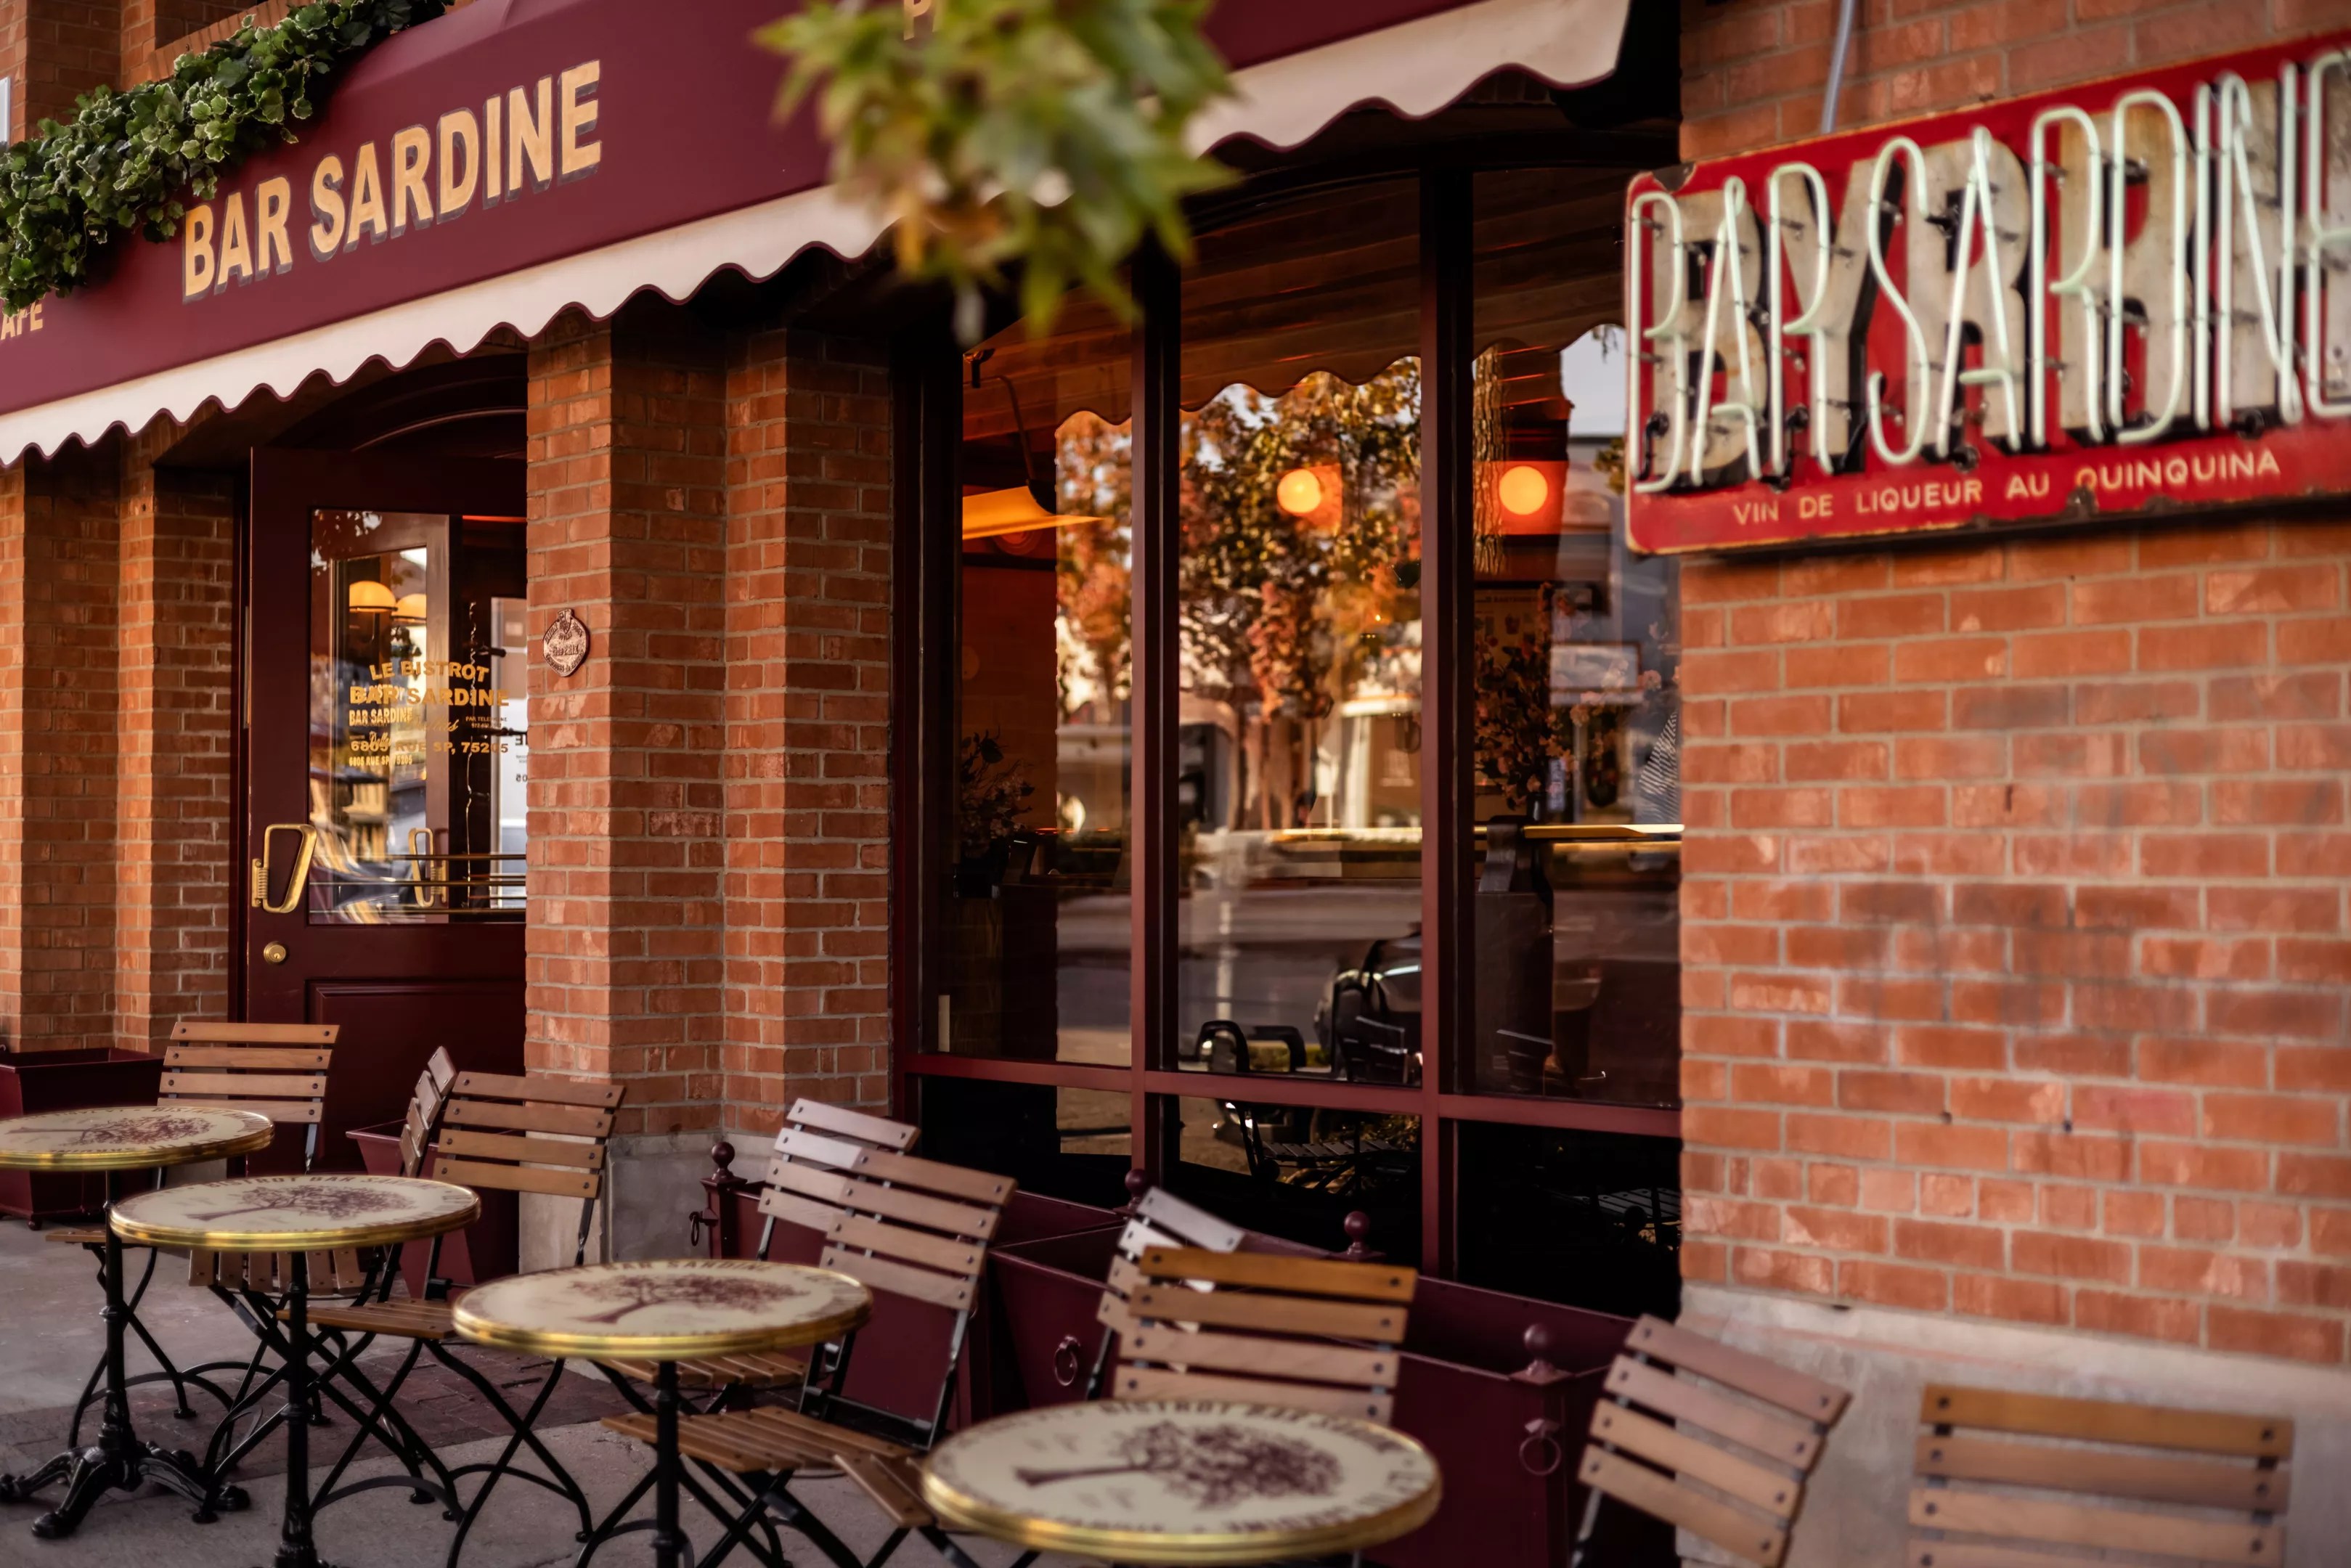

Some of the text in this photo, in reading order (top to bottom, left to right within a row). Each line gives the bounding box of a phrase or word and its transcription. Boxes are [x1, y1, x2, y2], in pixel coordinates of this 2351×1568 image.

[183, 60, 603, 303] BAR SARDINE
[1631, 49, 2351, 493] BAR SARDINE
[1733, 447, 2281, 525] VIN DE LIQUEUR AU QUINQUINA
[369, 661, 489, 682] LE BISTROT
[350, 686, 510, 706] BAR SARDINE
[349, 706, 413, 726] BAR SARDINE
[433, 741, 455, 754] SP,
[461, 741, 509, 754] 75205
[366, 756, 380, 766] RUE
